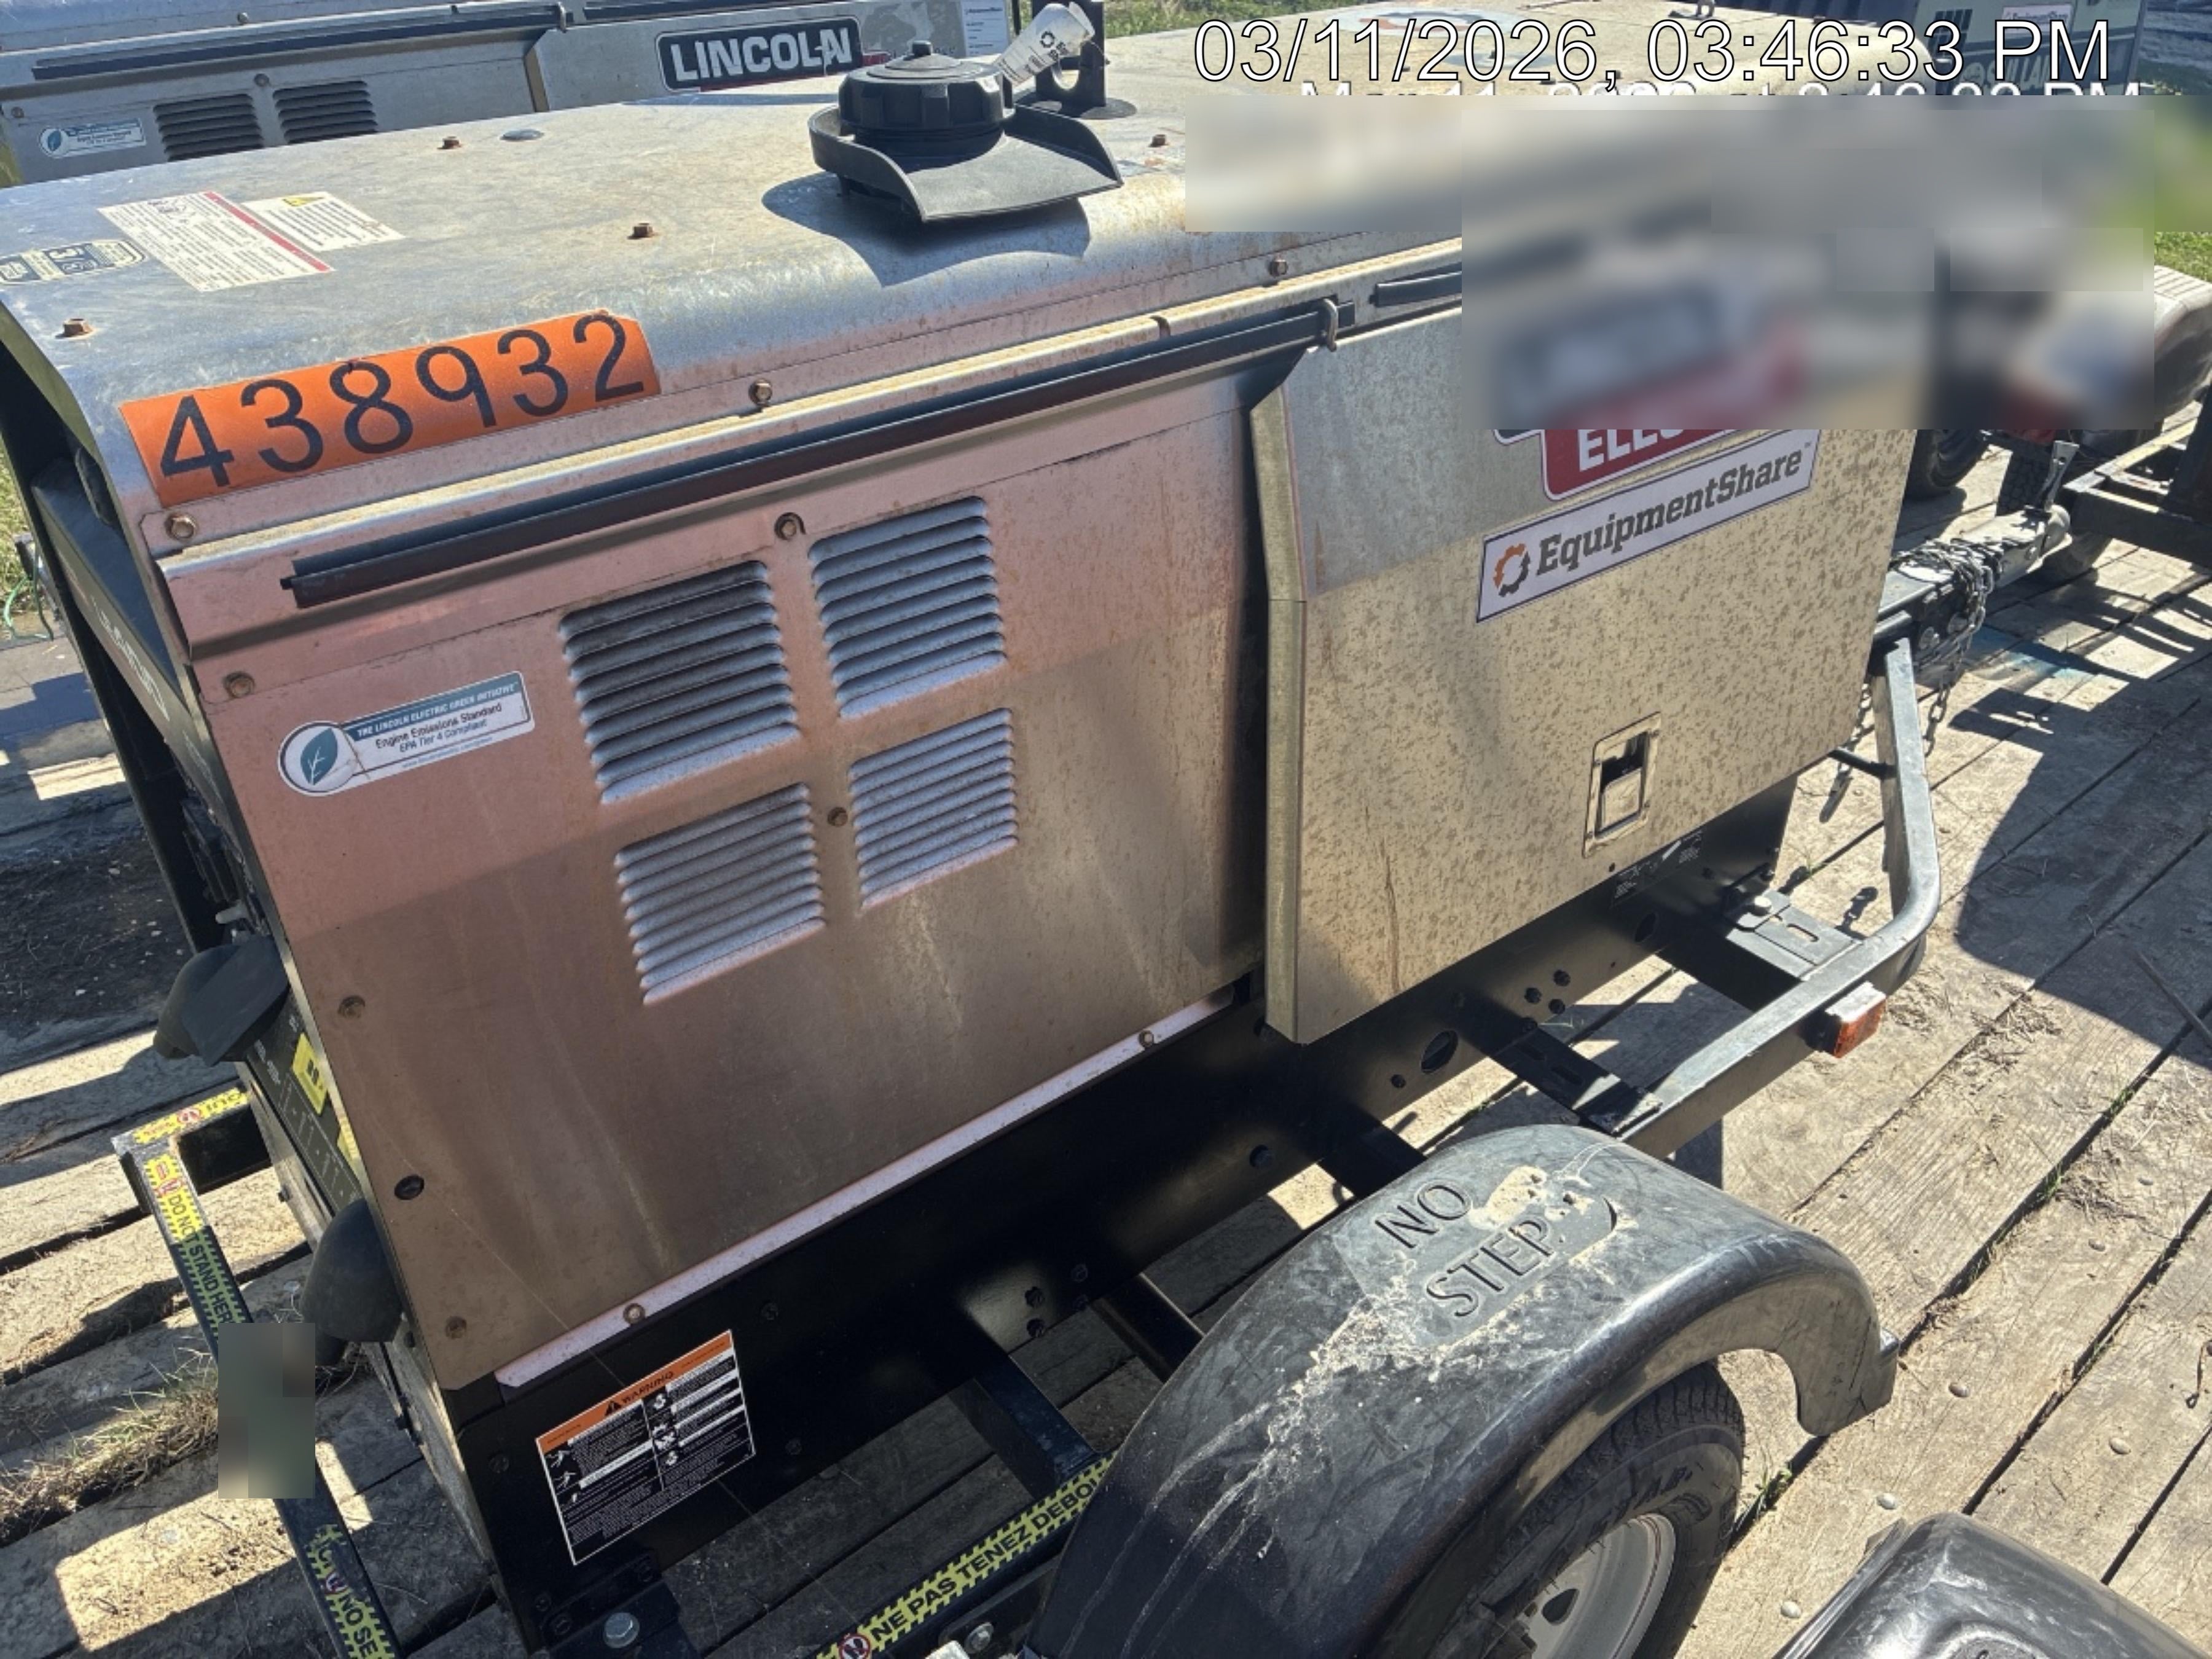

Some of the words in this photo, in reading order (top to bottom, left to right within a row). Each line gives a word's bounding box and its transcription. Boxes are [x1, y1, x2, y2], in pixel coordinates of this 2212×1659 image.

[670, 28, 852, 81] LINCOLN
[159, 313, 644, 488] 438932
[1536, 449, 1802, 576] EquipmentShare
[357, 725, 372, 737] THE
[375, 713, 410, 732] LINCOLN
[410, 704, 448, 721] ELECTRIC
[375, 734, 407, 749] Engine
[460, 702, 502, 723] Standard
[399, 741, 417, 753] EPA
[420, 736, 434, 747] Tier
[168, 1194, 186, 1215] DO
[1375, 1180, 1472, 1249] NO
[176, 1214, 200, 1244] NOT
[189, 1243, 219, 1292] STAND
[1426, 1218, 1556, 1317] STEP
[210, 1290, 234, 1323] HER
[622, 1371, 674, 1404] WARNING
[870, 1610, 908, 1641] NE
[908, 1577, 957, 1615] PAS
[956, 1525, 1033, 1578] TENEZ
[1030, 1478, 1098, 1530] DEBO
